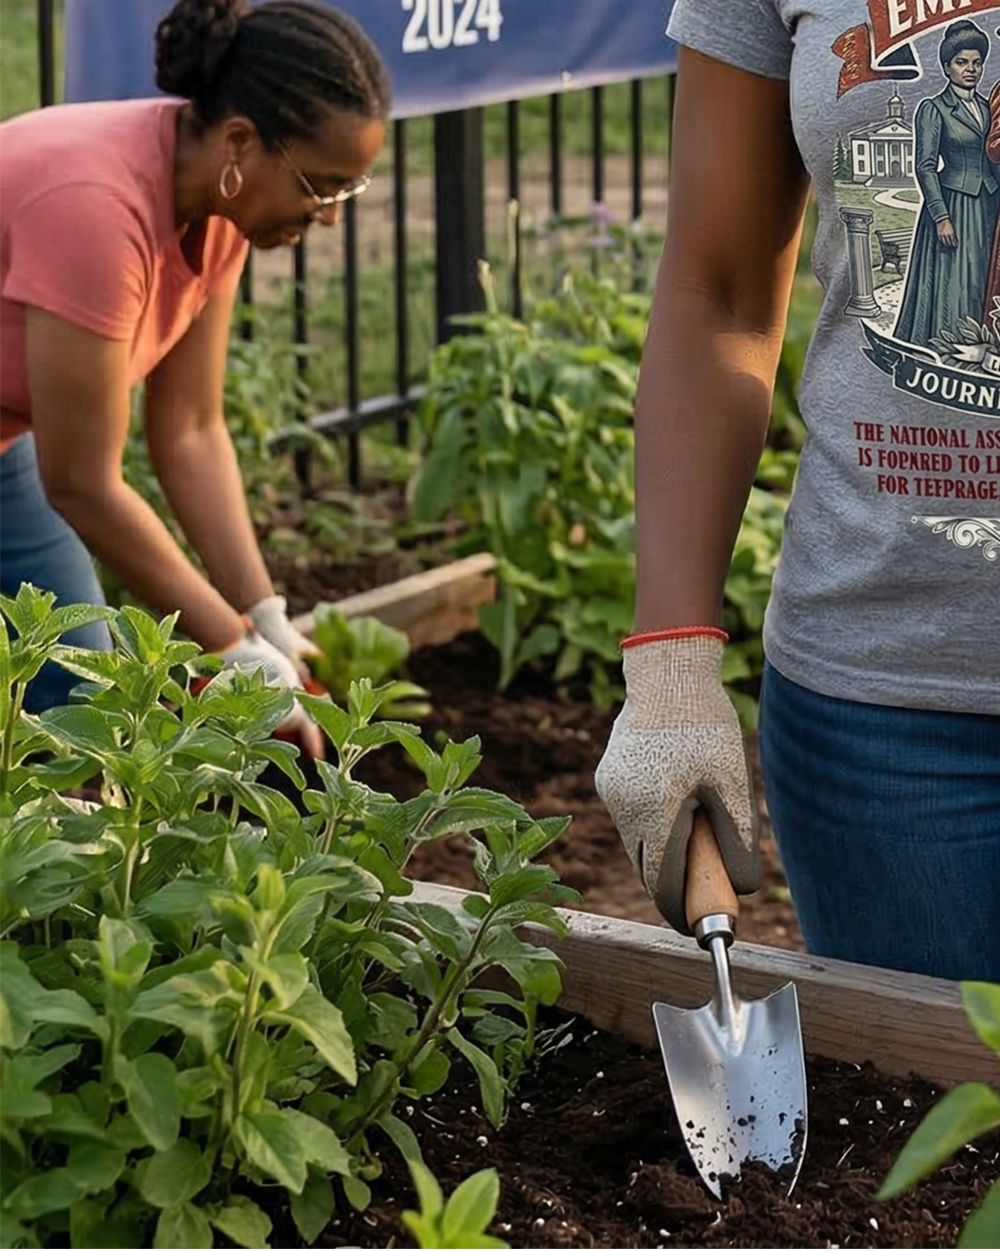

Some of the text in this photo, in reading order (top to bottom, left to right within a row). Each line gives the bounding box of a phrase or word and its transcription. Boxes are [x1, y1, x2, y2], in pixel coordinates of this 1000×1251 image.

[853, 421, 885, 443] THE
[890, 425, 971, 449] NATIONAL
[858, 447, 873, 468] IS
[958, 454, 981, 474] TO
[877, 474, 909, 496] FOR
